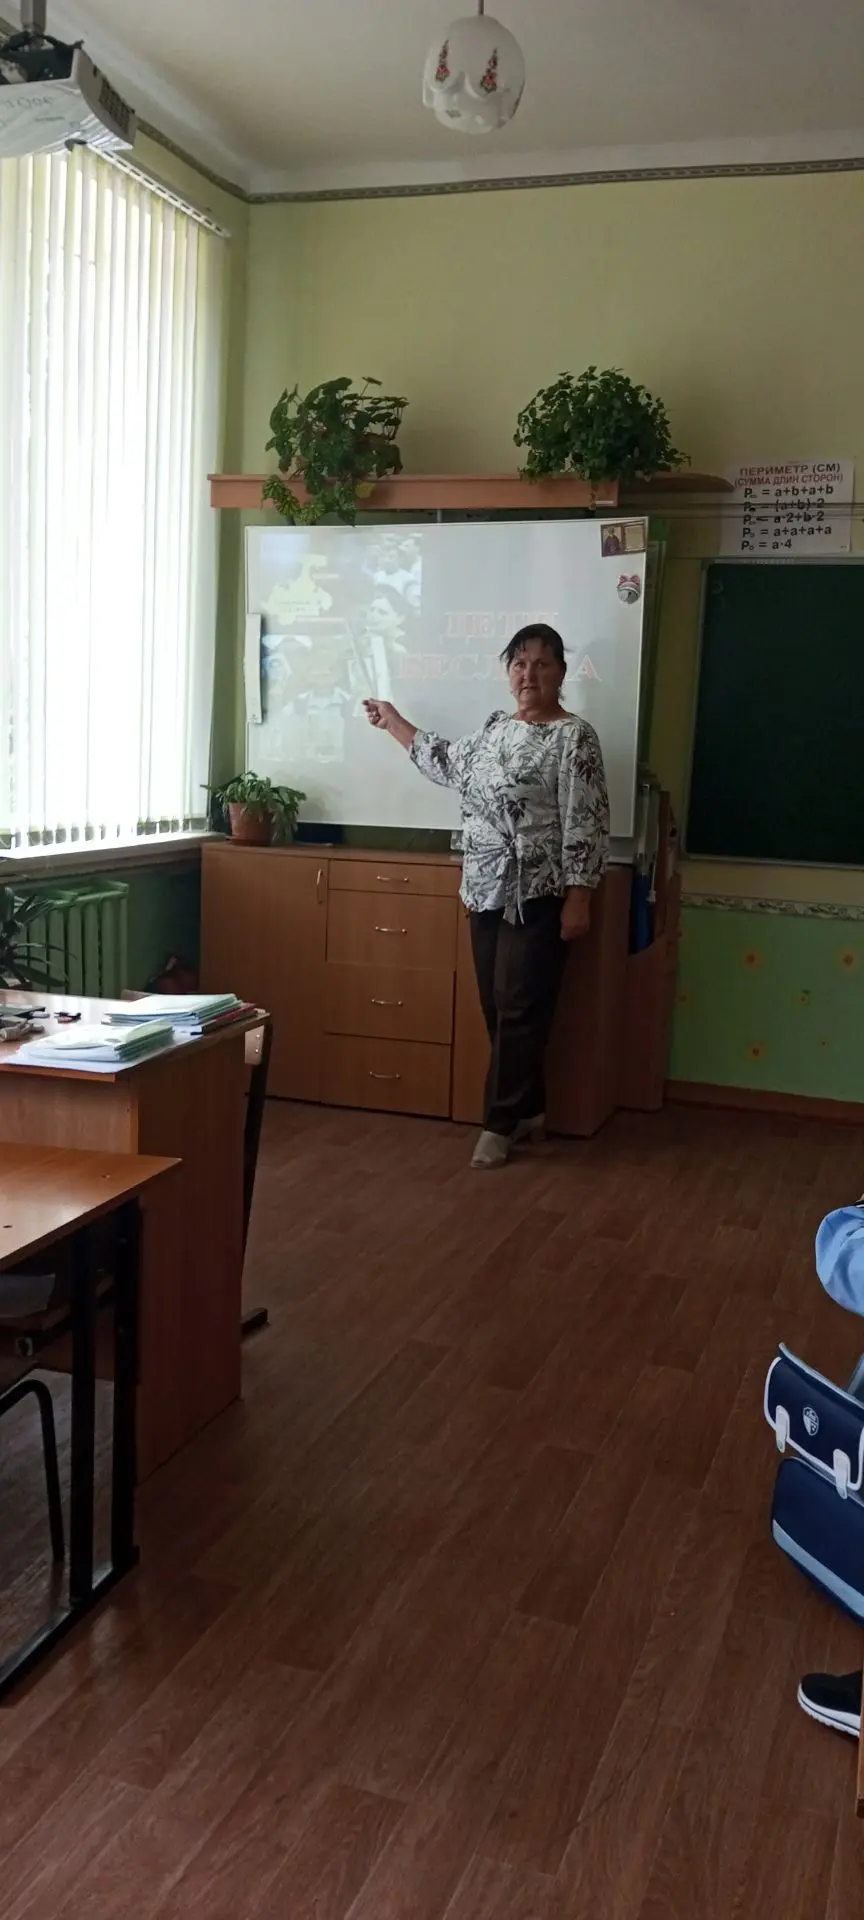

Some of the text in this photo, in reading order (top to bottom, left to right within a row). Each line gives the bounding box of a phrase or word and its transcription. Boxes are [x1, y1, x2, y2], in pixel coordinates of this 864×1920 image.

[740, 463, 840, 476] ПЕРИМЕТР (СМ)
[734, 473, 844, 488] (СУММА ДЛИН СТОРОН)
